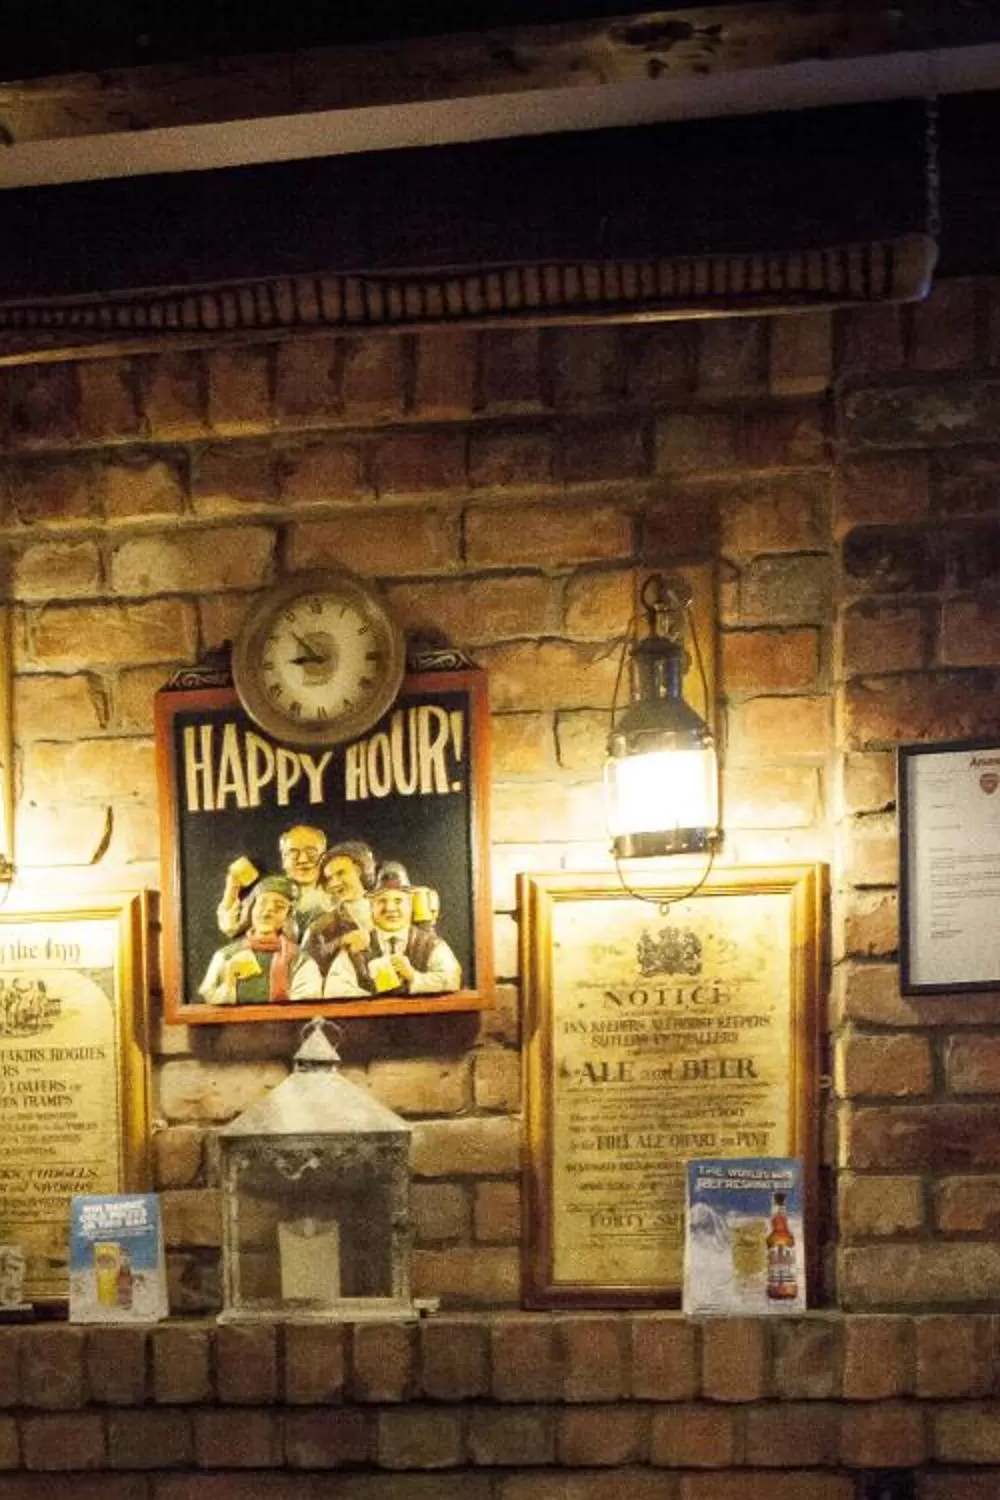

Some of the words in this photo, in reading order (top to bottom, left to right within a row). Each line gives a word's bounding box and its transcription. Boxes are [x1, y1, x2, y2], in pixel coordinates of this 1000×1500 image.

[183, 722, 333, 811] HAPPY
[345, 706, 464, 801] HOUR!
[9, 938, 38, 961] the
[45, 937, 81, 964] Inn
[603, 985, 733, 1008] NOTICE
[578, 1060, 636, 1085] ALE
[640, 1064, 674, 1082] and
[681, 1057, 759, 1081] BEER
